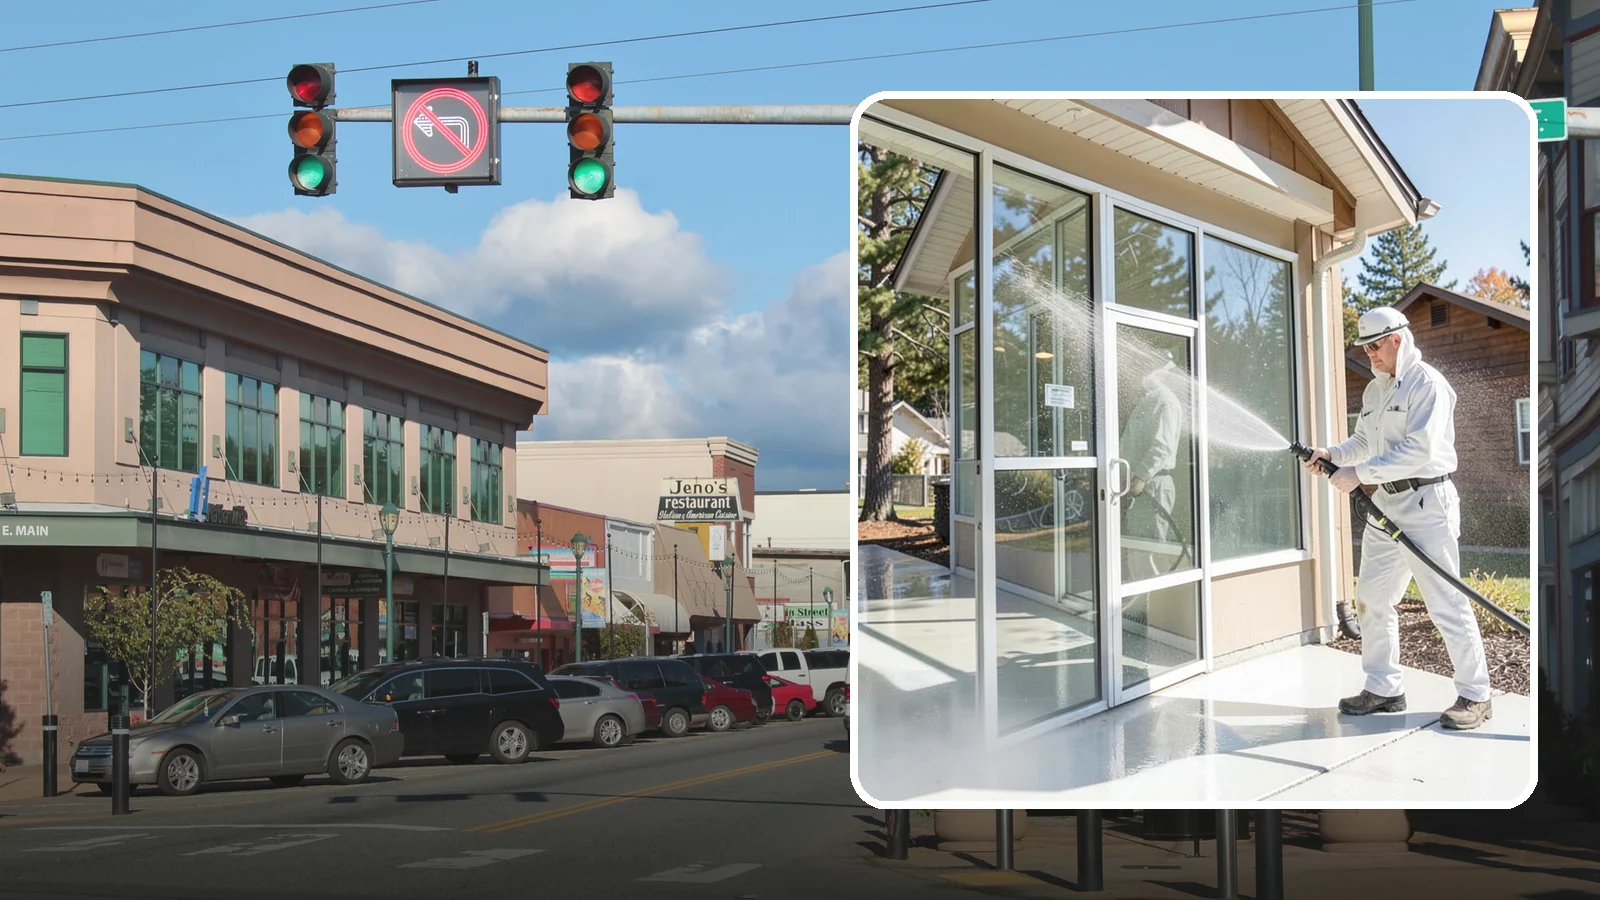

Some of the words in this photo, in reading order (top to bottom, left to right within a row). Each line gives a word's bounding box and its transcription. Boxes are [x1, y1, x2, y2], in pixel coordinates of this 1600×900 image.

[669, 480, 728, 494] Jeno's
[665, 496, 731, 509] restaurant
[686, 509, 714, 519] American
[715, 509, 737, 519] Cuisine
[2, 525, 13, 536] E.
[15, 525, 49, 537] MAIN
[797, 608, 828, 616] Street
[791, 619, 823, 627] lass
